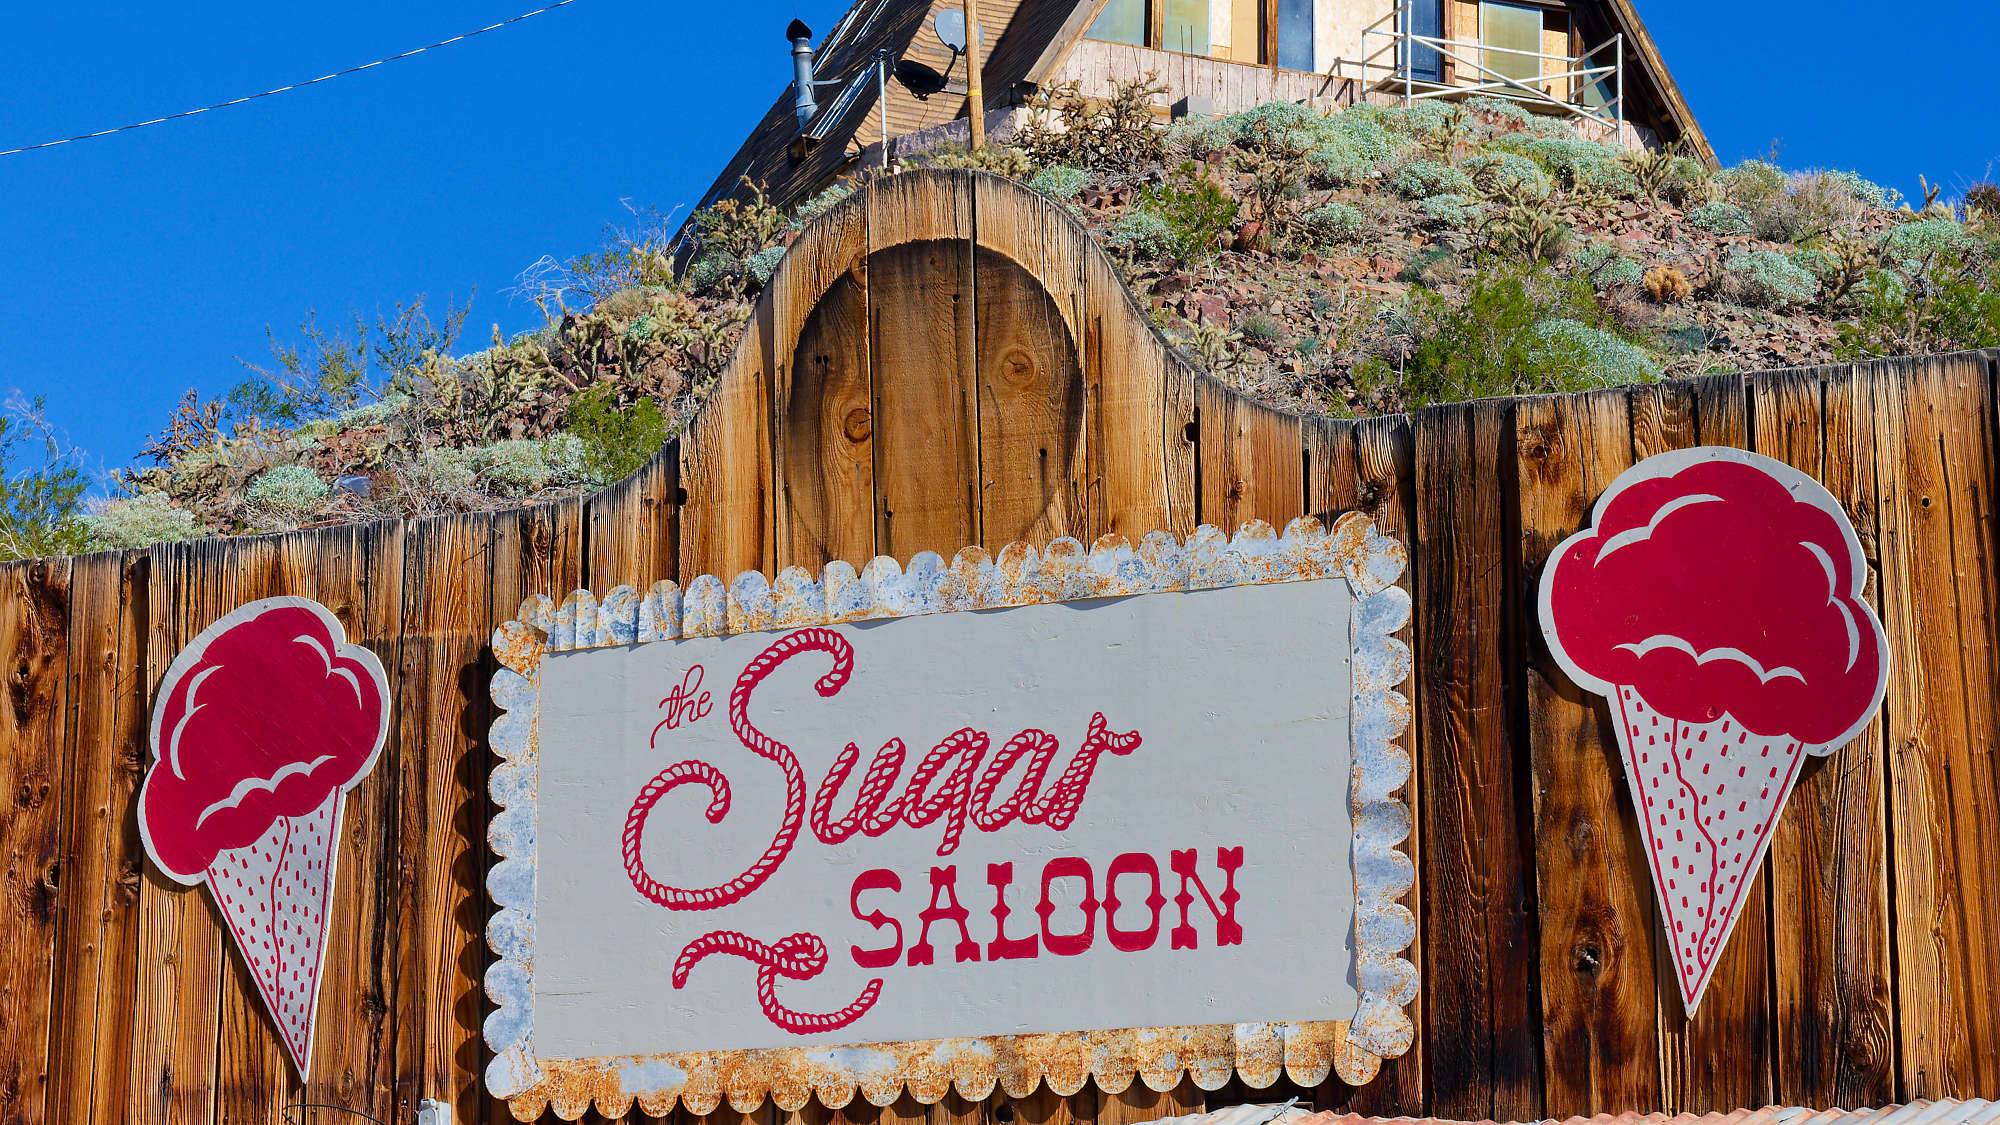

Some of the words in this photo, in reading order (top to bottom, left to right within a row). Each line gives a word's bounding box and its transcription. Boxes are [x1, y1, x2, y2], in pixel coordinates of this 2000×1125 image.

[651, 664, 713, 749] the
[622, 628, 1142, 911] Sugar
[850, 846, 1243, 968] SALOON
